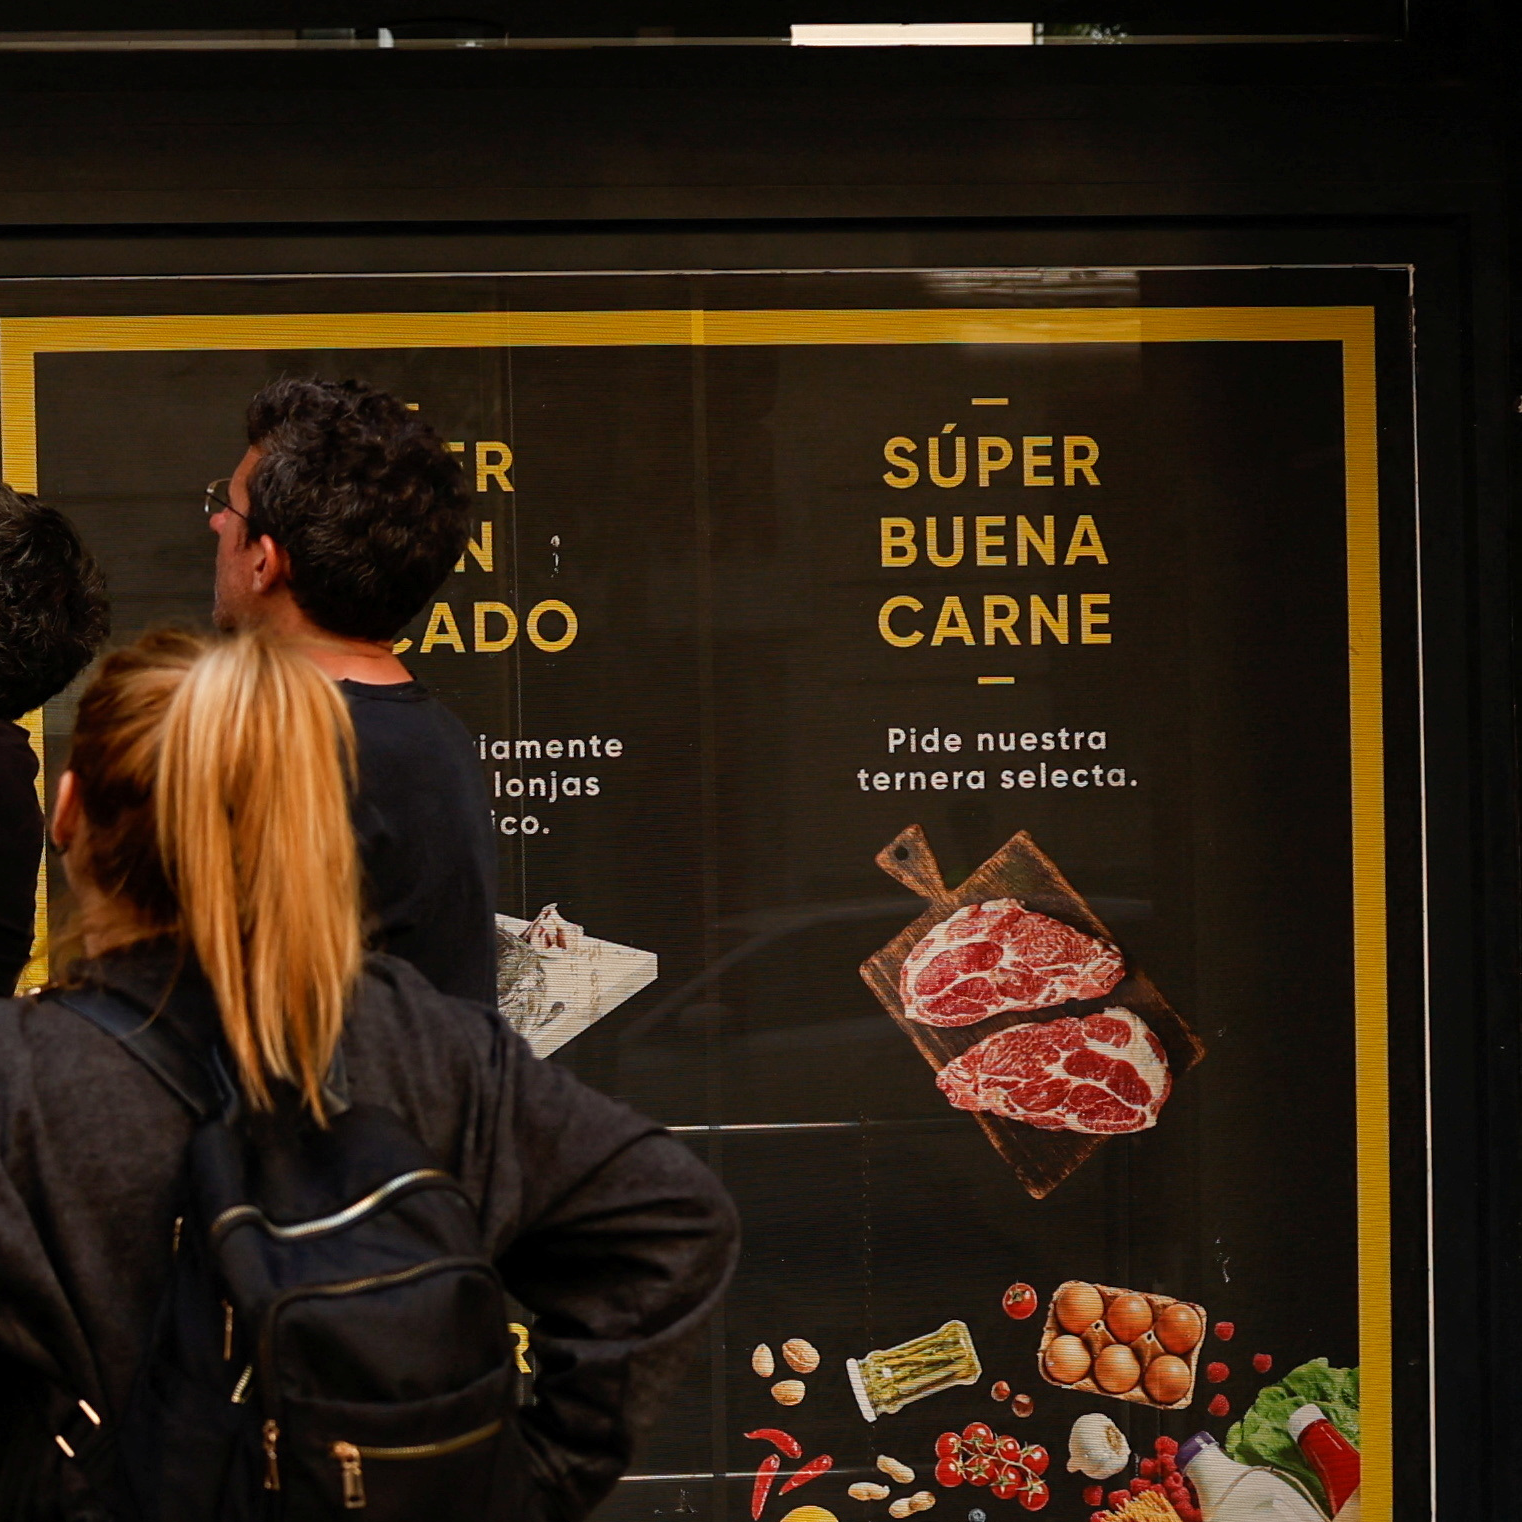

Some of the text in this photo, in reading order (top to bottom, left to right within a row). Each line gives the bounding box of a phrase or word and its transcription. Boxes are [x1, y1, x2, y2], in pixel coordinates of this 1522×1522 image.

[882, 422, 1102, 490] SÚPER
[880, 514, 1110, 568] BUENA
[877, 593, 1113, 648] CARNE
[887, 727, 1107, 753] Pide nuestra
[857, 761, 1138, 791] ternera selecta.
